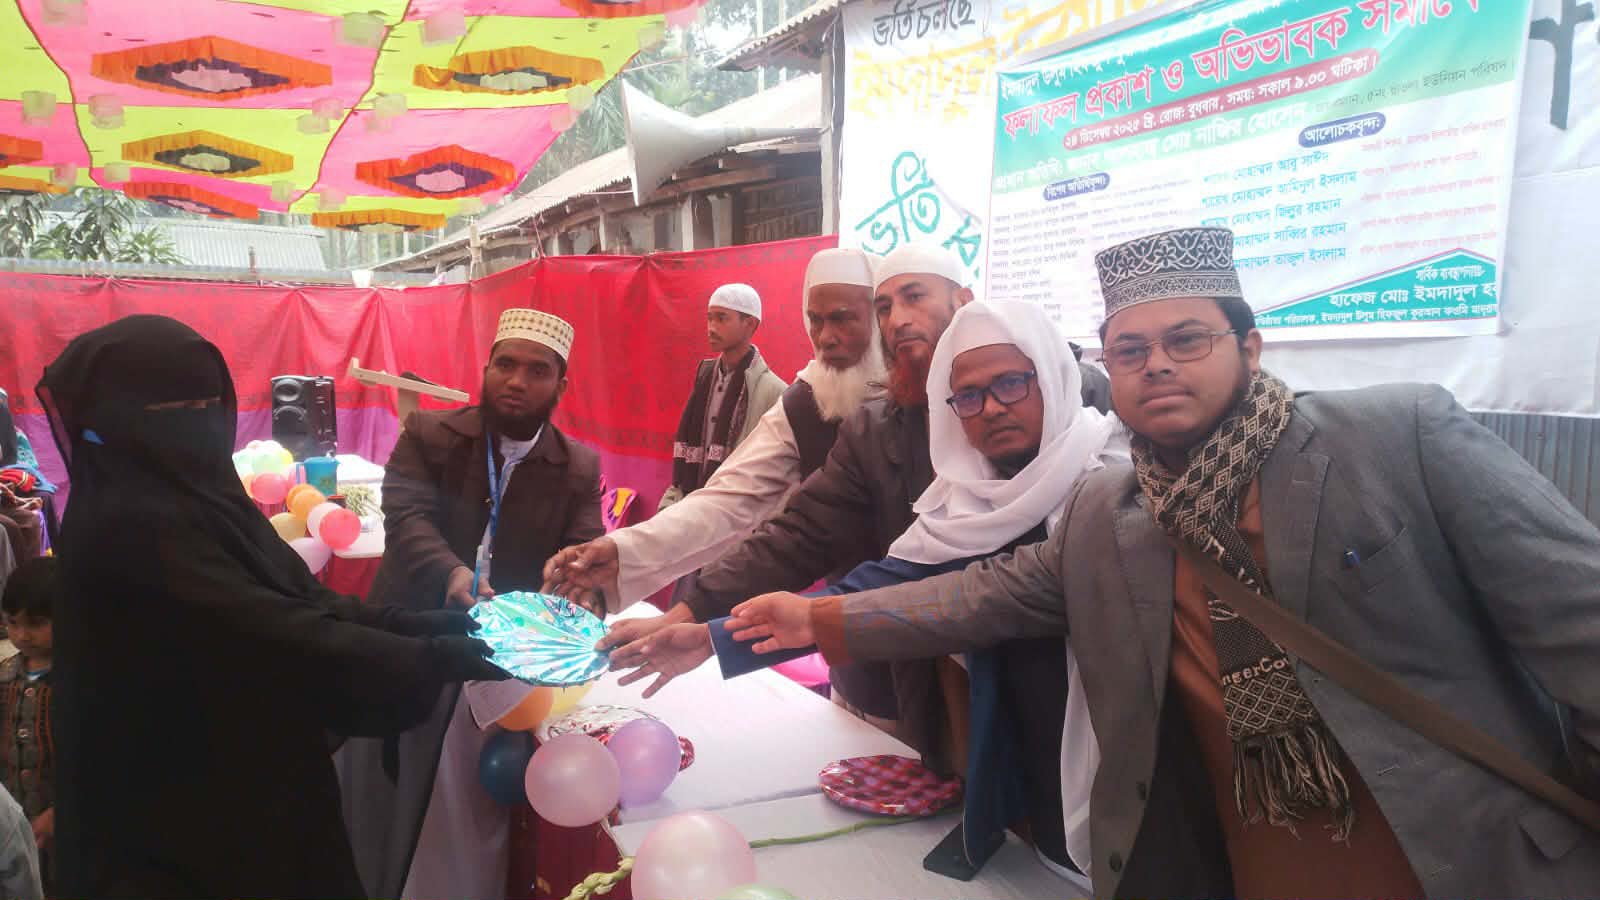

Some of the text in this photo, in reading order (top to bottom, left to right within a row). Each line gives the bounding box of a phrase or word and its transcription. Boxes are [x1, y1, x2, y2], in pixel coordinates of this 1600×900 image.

[1003, 91, 1080, 136] ফলাফল
[1085, 63, 1154, 117] প্রকাশ
[1162, 59, 1184, 92] ও
[1192, 7, 1352, 82] অভিভাবক
[1113, 118, 1140, 137] ২০২৫
[1258, 77, 1292, 98] সকাল
[1294, 71, 1326, 90] ৯.০০
[854, 150, 942, 257] ভর্তি
[1309, 248, 1347, 263] ইসলাম
[1413, 283, 1478, 303] ইমদাদুল
